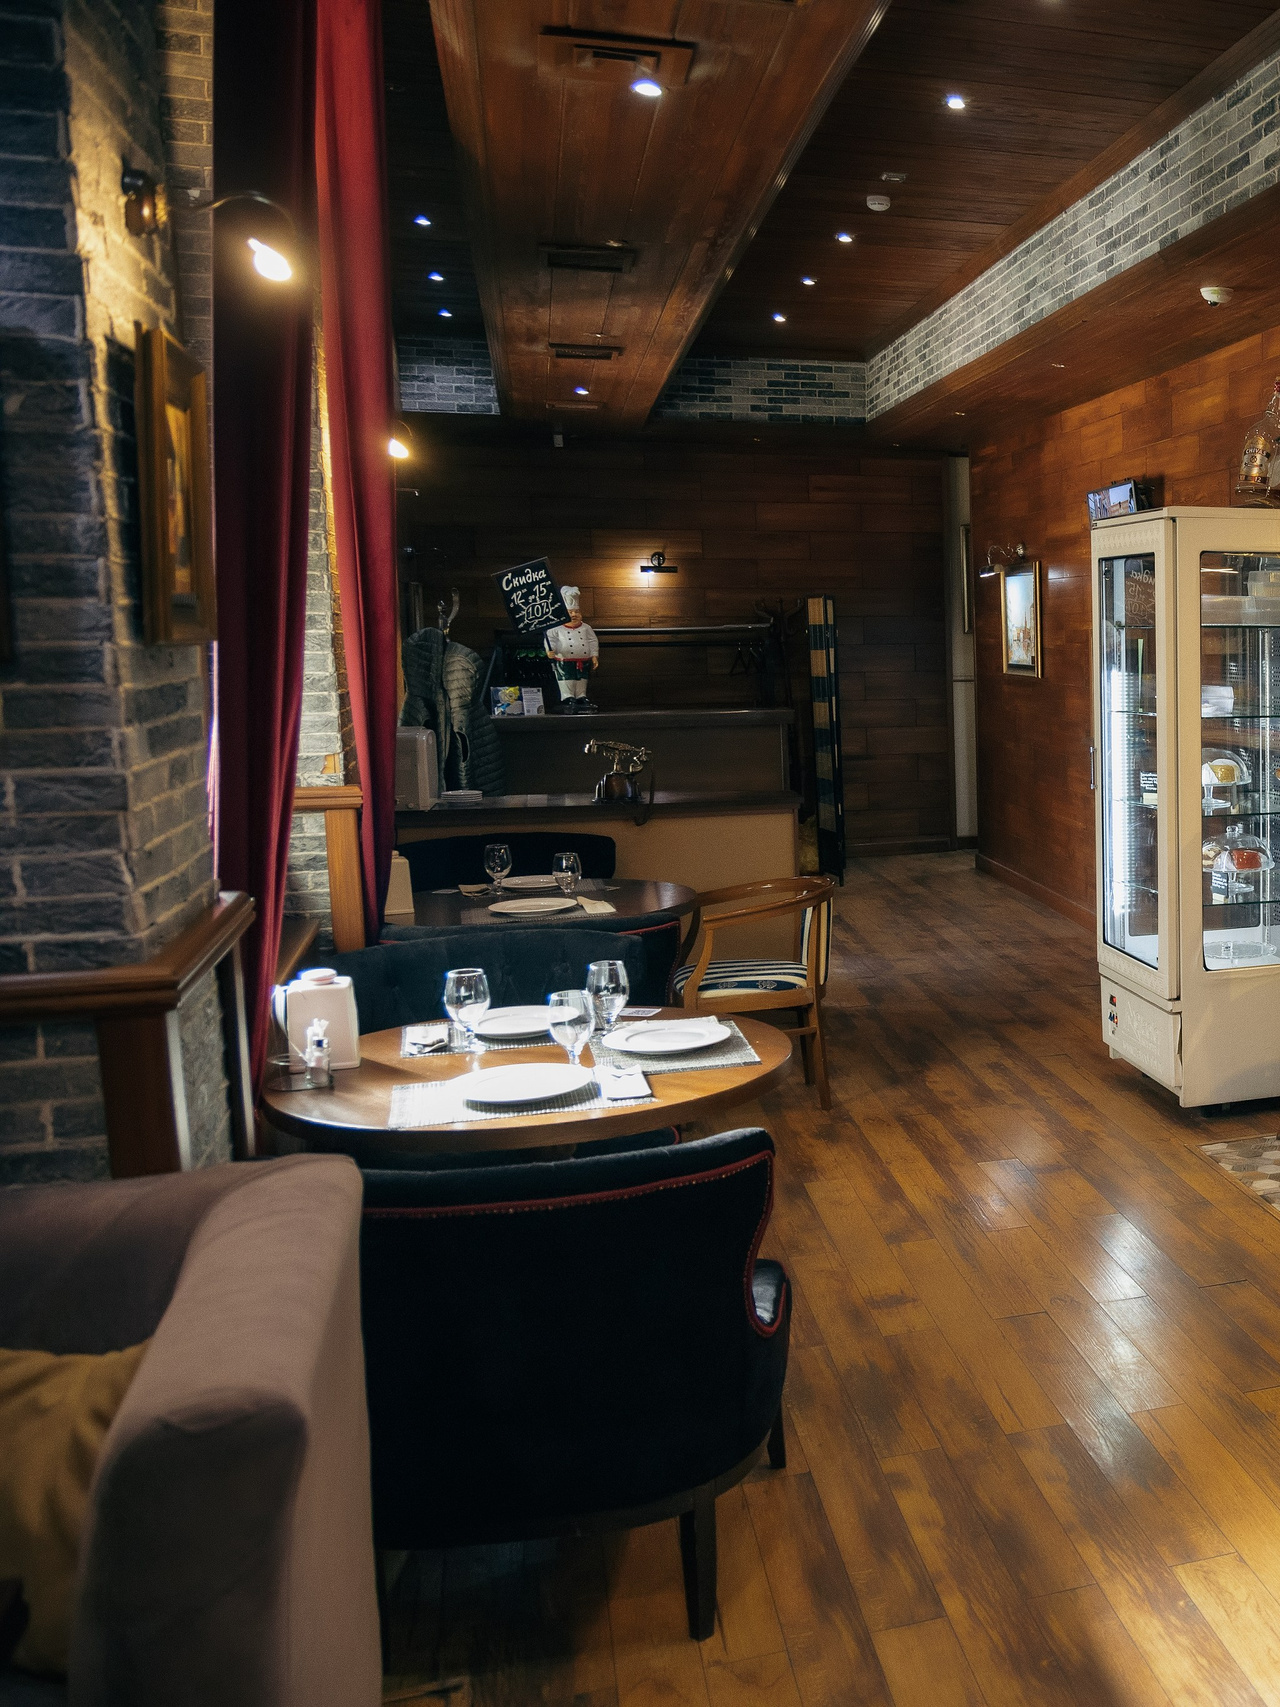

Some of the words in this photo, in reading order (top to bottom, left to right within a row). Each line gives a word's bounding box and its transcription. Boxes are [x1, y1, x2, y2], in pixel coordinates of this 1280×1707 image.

[1245, 448, 1267, 456] CHIVAS
[502, 568, 547, 591] Скидка
[527, 602, 550, 620] 10%
